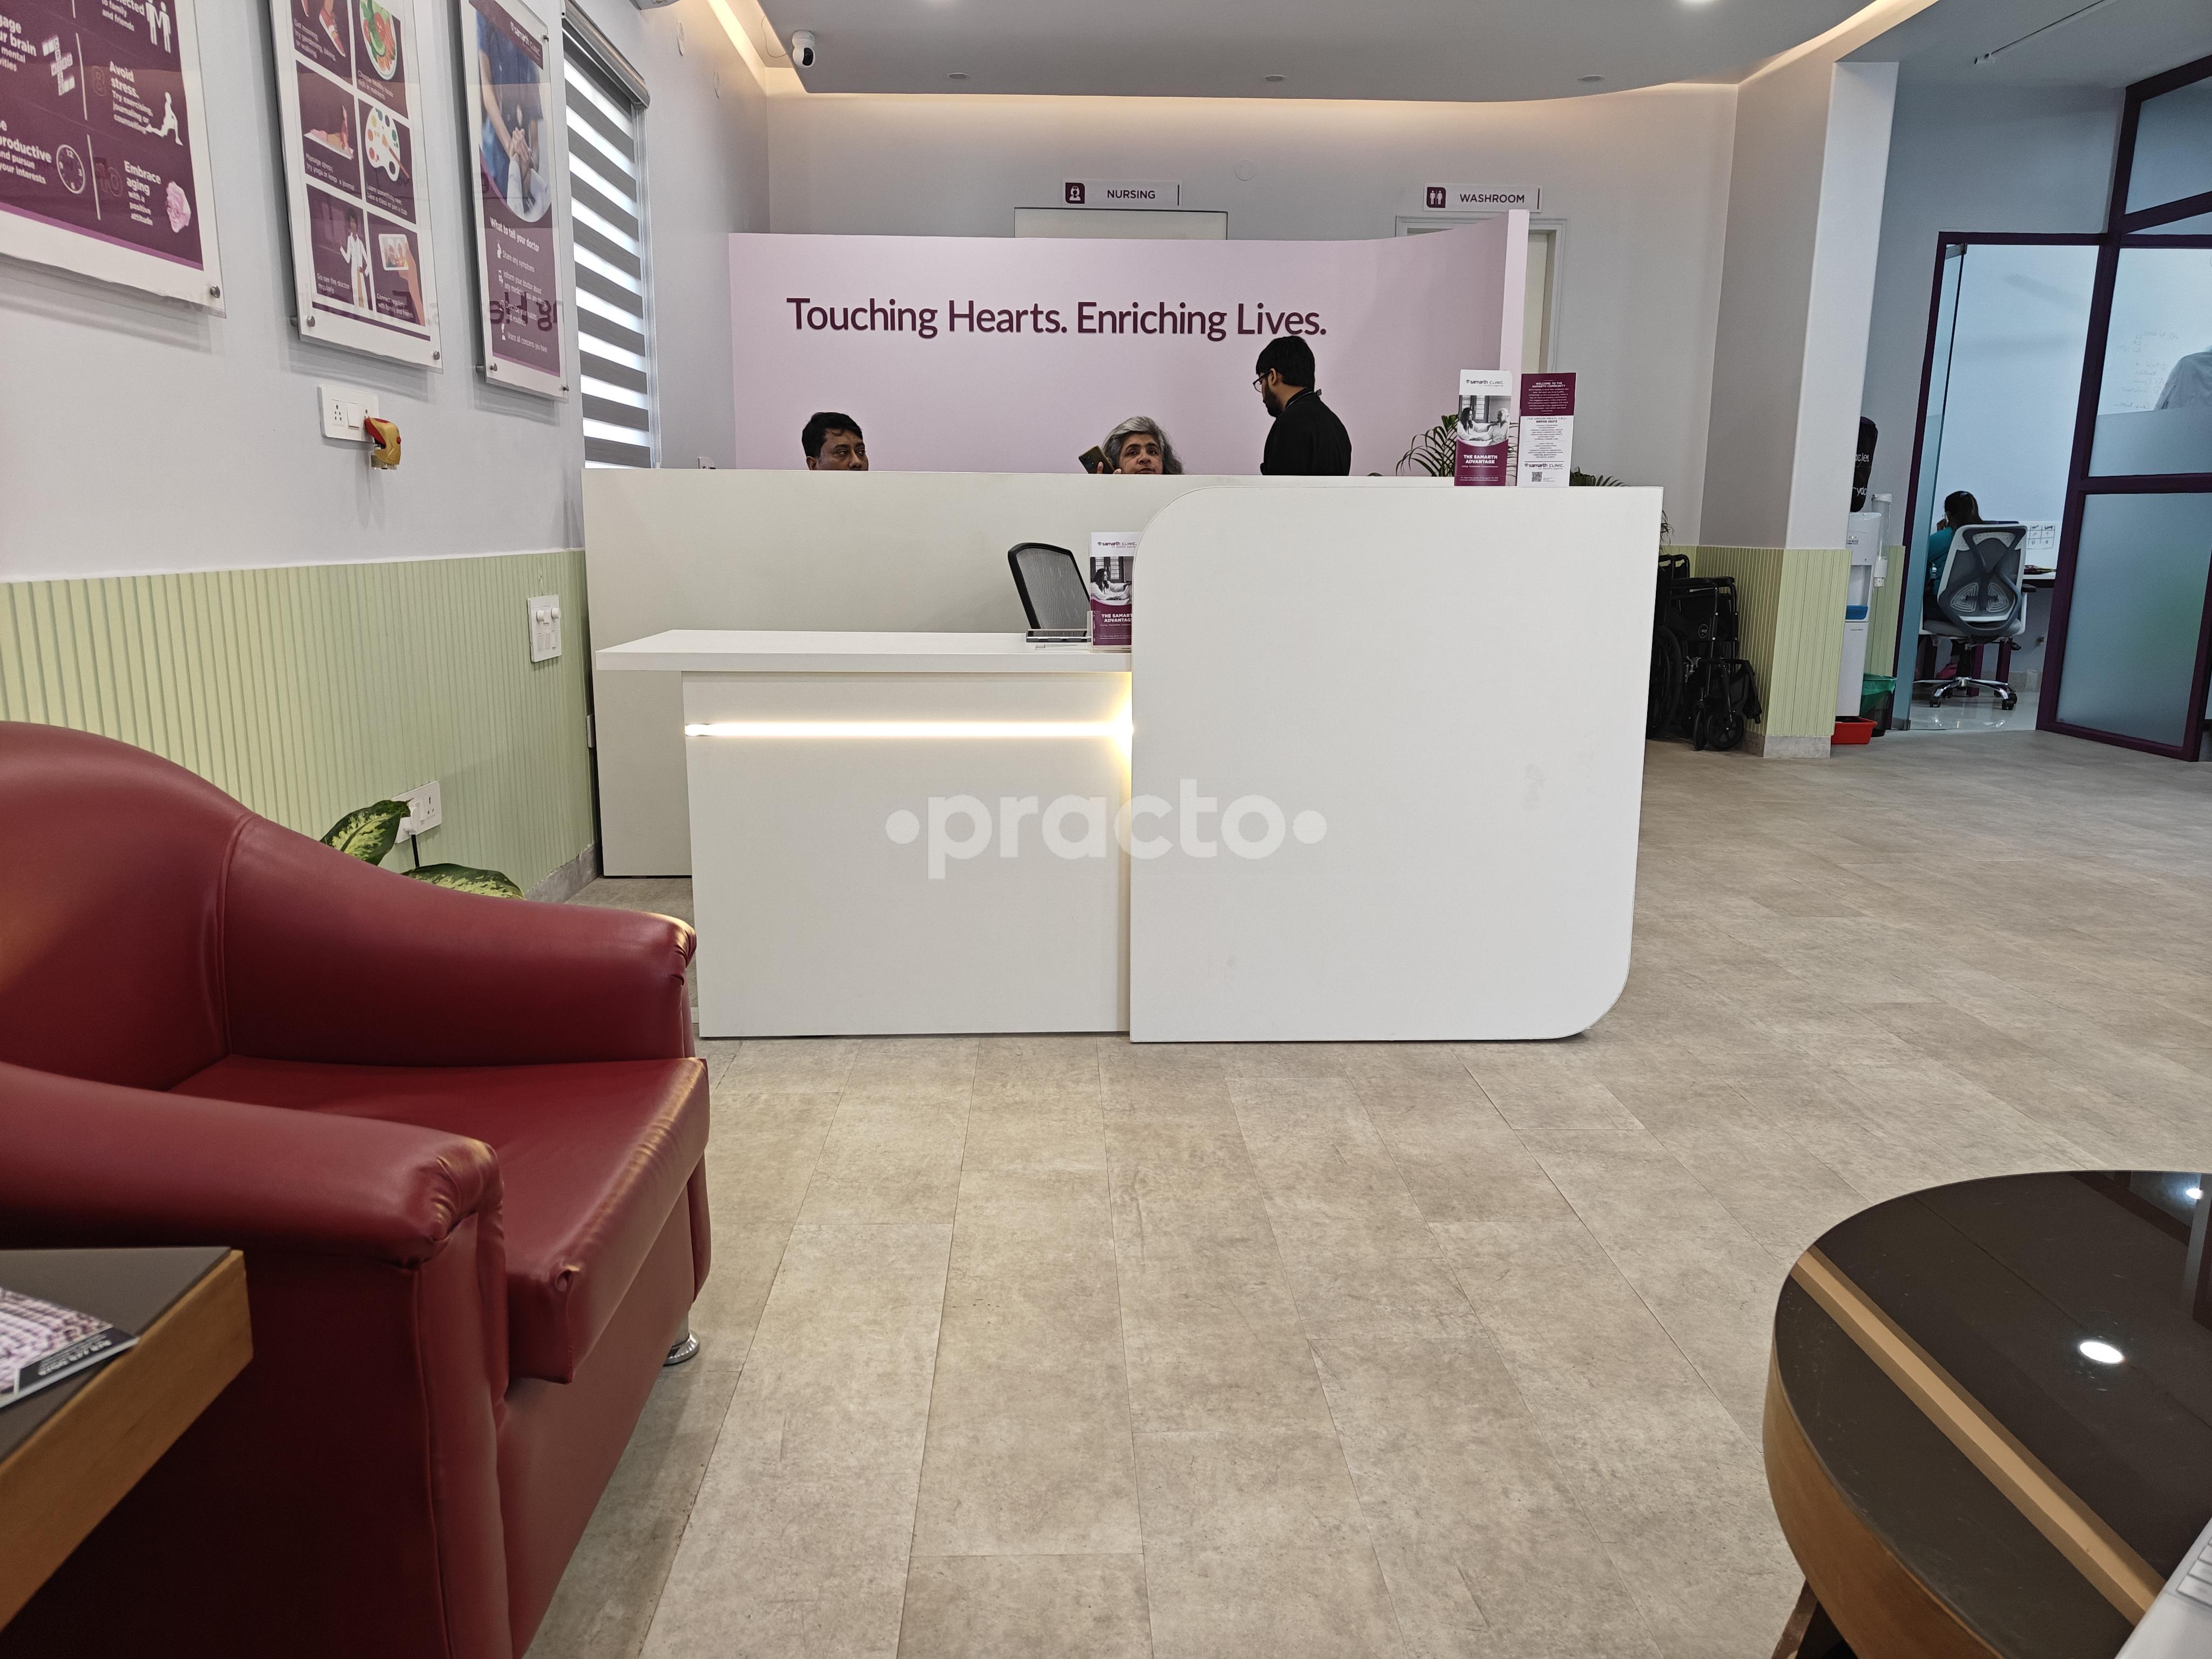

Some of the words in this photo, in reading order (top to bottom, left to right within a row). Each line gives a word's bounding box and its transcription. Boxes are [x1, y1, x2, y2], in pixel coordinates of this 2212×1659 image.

[102, 9, 114, 21] and
[114, 14, 134, 31] friends
[109, 1, 127, 18] family
[1, 46, 26, 63] mental
[10, 32, 37, 57] brain
[110, 60, 134, 83] Avoid
[0, 151, 10, 160] nd
[12, 154, 35, 170] pursue
[124, 160, 161, 185] Embrace
[126, 177, 150, 197] aging
[1107, 189, 1156, 199] NURSING
[1459, 193, 1525, 204] WASHROOM
[490, 217, 503, 233] What
[503, 224, 509, 235] to
[516, 233, 526, 245] your
[526, 238, 539, 252] doctor
[786, 298, 938, 339] Touching
[948, 300, 1068, 334] Hearts.
[1077, 301, 1228, 342] Enriching
[1237, 302, 1327, 335] Lives.
